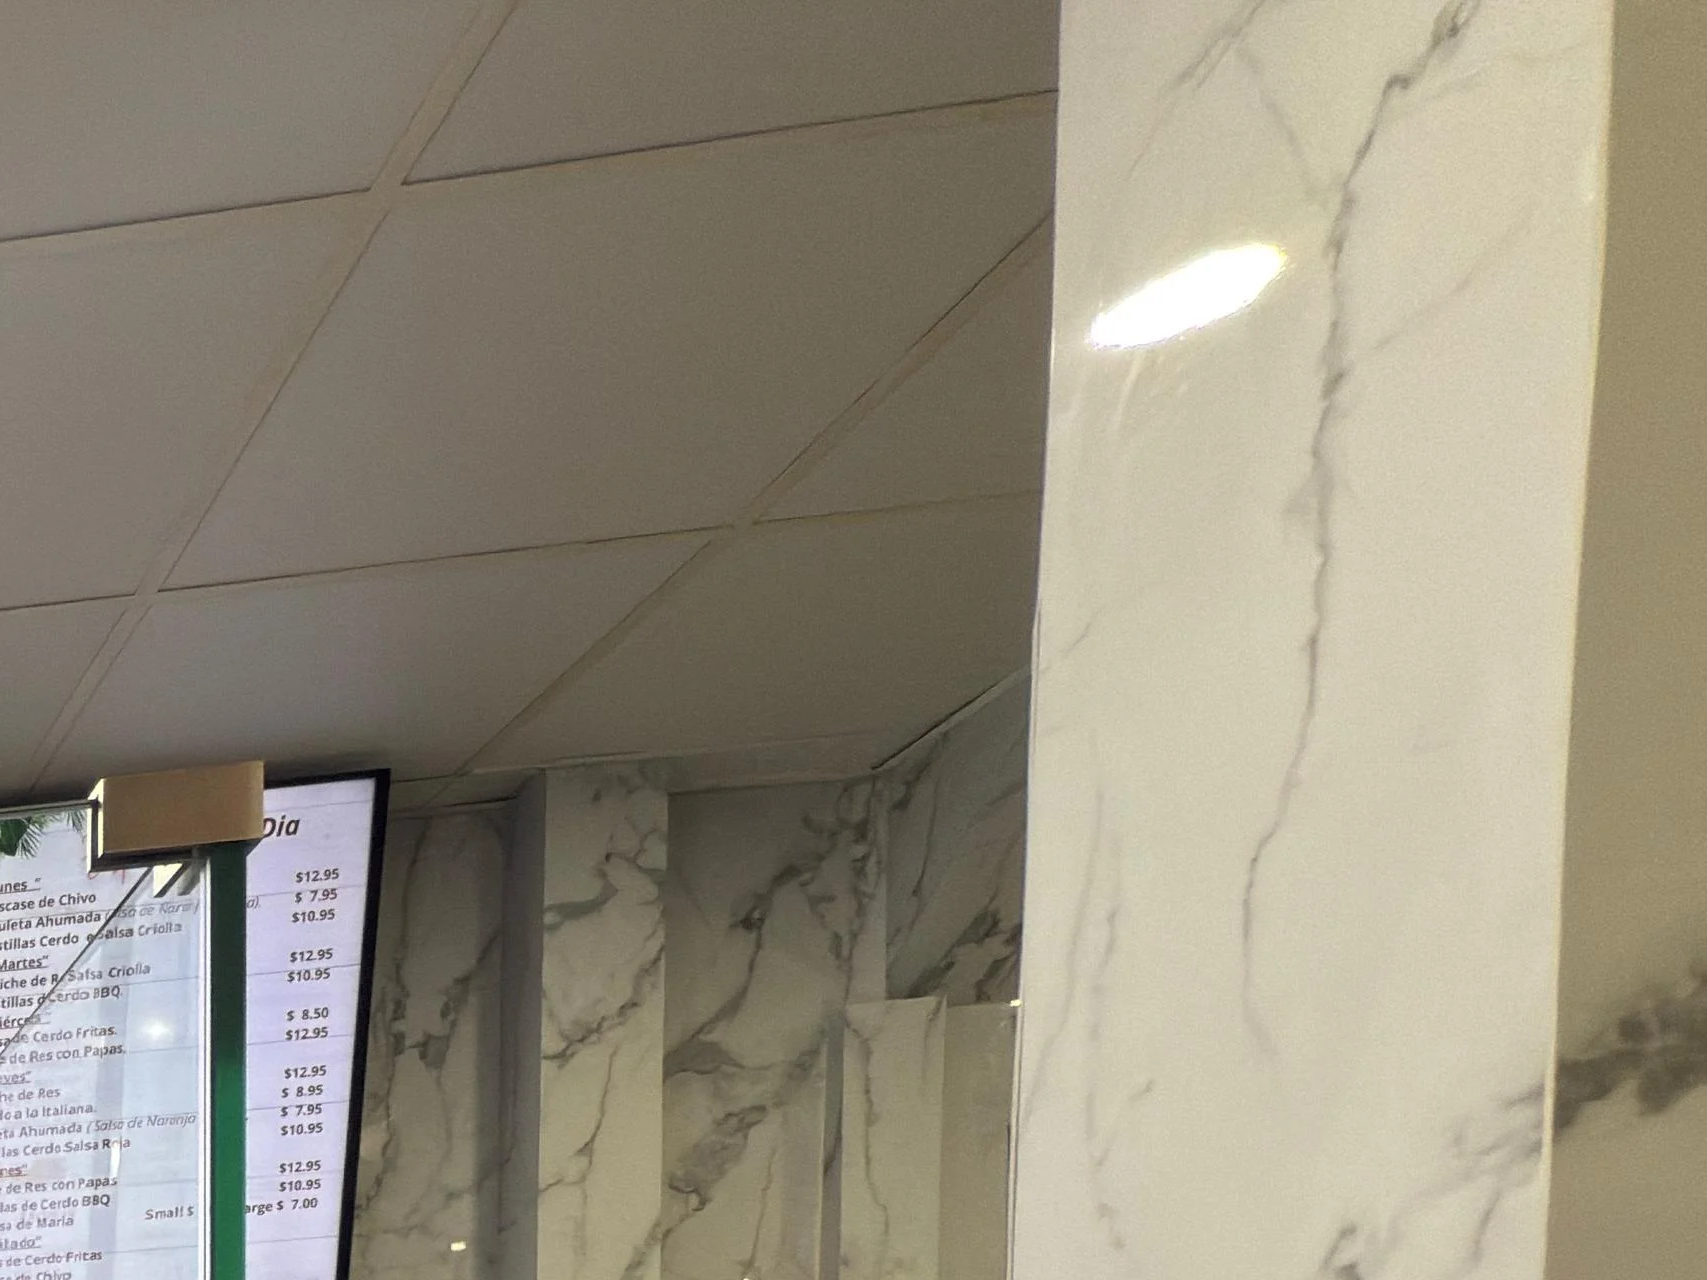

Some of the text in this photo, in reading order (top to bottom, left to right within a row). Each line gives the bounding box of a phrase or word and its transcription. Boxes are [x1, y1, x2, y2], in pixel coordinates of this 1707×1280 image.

[296, 868, 339, 883] $12.95
[38, 895, 55, 908] de
[59, 892, 96, 905] Chivo
[292, 908, 335, 923] $10.95
[290, 948, 333, 963] $12.95
[287, 967, 333, 983] $10.95
[285, 1026, 328, 1041] $12.95
[284, 1065, 326, 1079] $12.95
